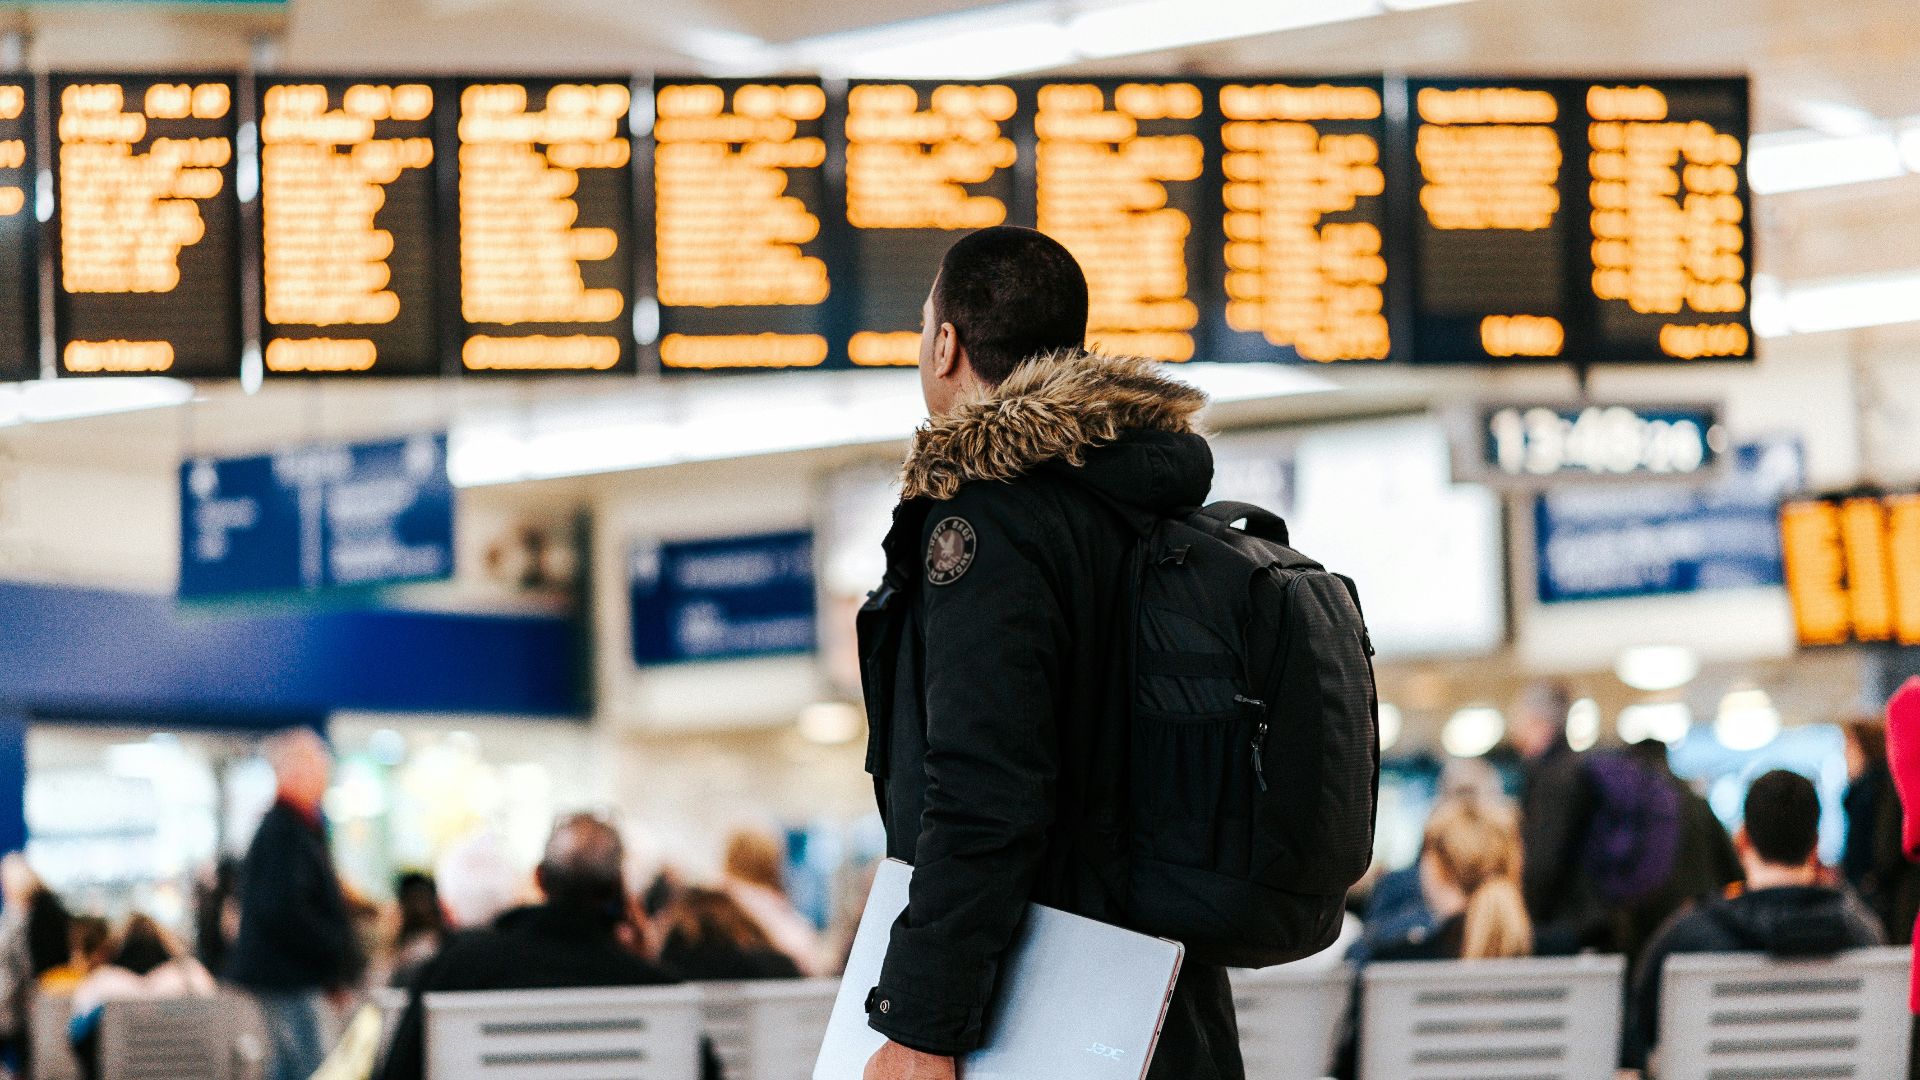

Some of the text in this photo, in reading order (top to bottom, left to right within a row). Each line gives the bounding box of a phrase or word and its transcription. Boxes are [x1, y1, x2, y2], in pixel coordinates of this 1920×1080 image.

[952, 520, 973, 542] BROS
[949, 552, 971, 578] YORK
[1086, 1042, 1125, 1061] acer
